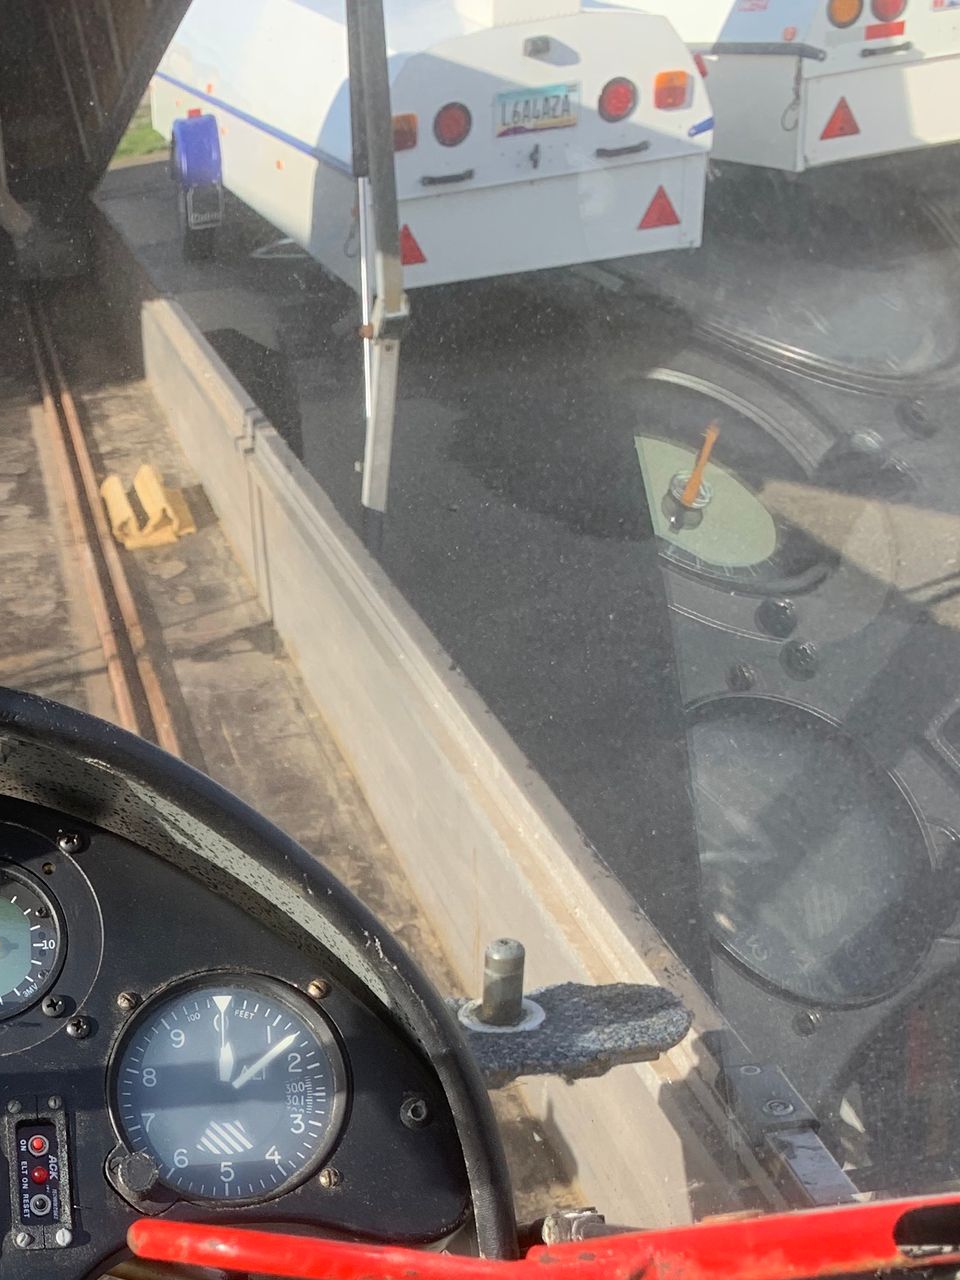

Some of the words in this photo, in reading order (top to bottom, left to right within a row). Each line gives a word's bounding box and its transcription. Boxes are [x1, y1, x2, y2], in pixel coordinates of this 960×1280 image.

[42, 939, 56, 950] 10
[186, 1012, 201, 1023] 100
[234, 1009, 256, 1020] FEET
[170, 1029, 185, 1049] 9
[266, 1025, 271, 1044] 1
[287, 1053, 303, 1073] 2
[142, 1068, 157, 1087] 8
[141, 1113, 156, 1133] 7
[290, 1113, 306, 1134] 3
[19, 1139, 27, 1152] ON
[265, 1145, 282, 1165] 4
[48, 1154, 59, 1180] ACK
[173, 1149, 189, 1168] 6
[20, 1161, 28, 1176] ELT
[220, 1162, 235, 1182] 5
[21, 1177, 29, 1190] ON
[22, 1194, 30, 1219] RESET
